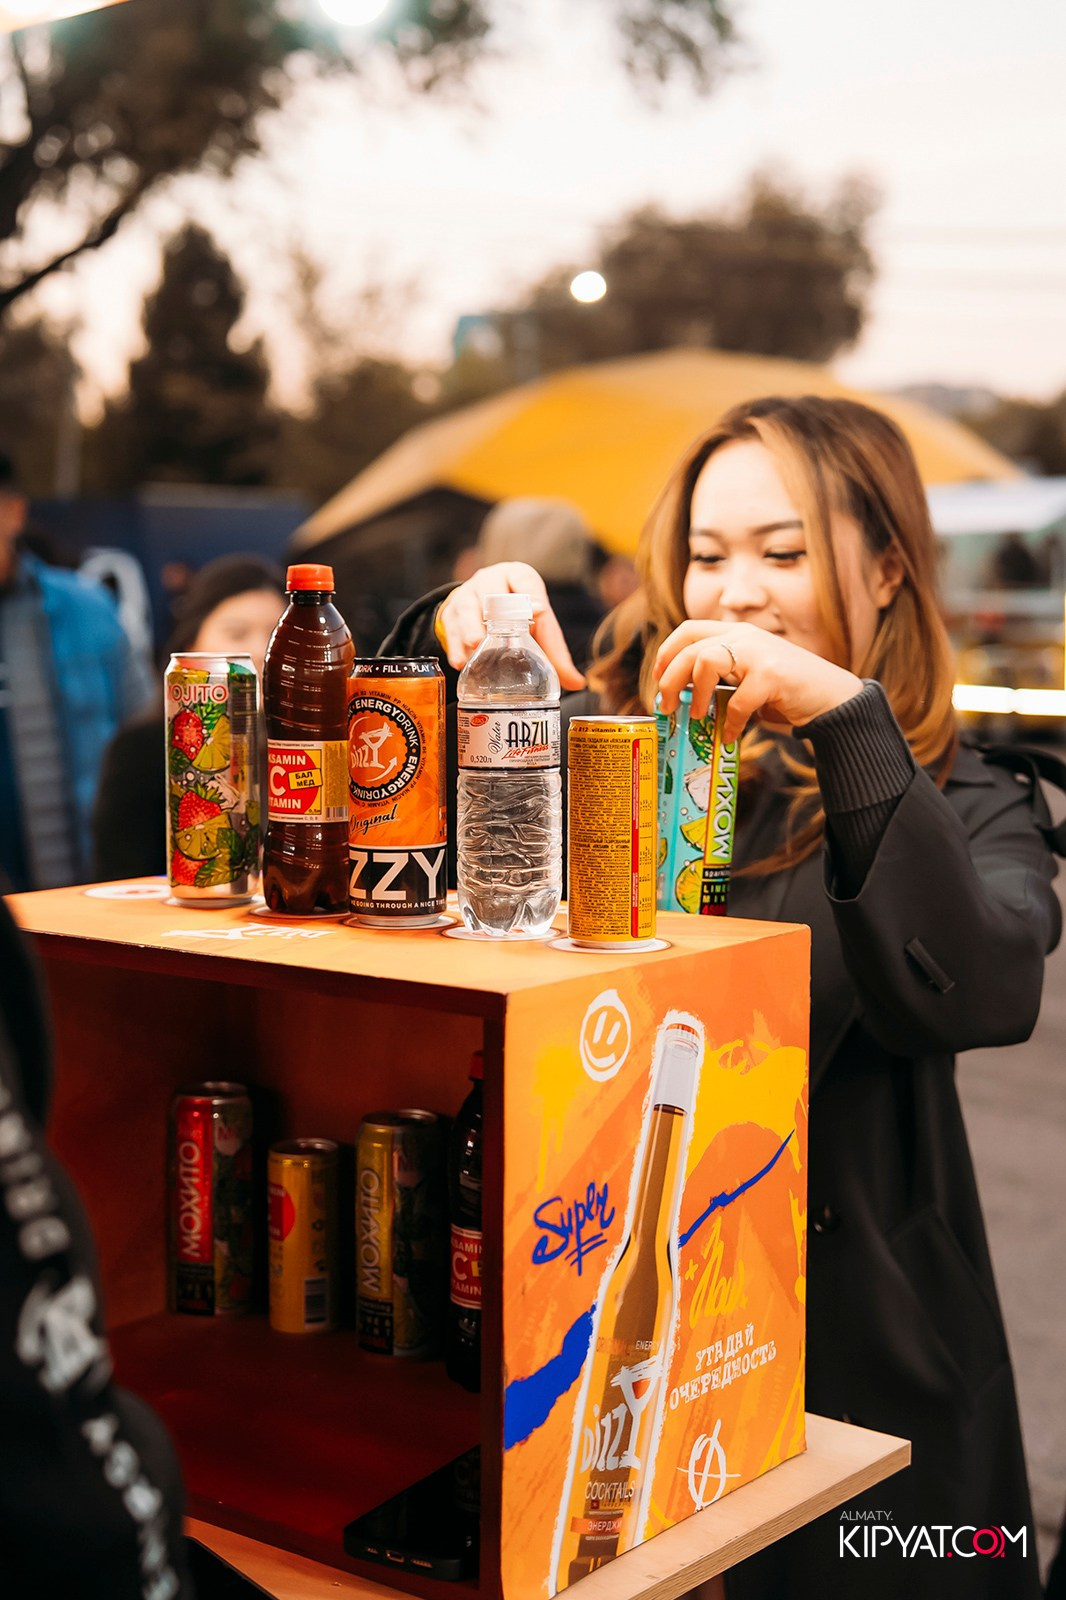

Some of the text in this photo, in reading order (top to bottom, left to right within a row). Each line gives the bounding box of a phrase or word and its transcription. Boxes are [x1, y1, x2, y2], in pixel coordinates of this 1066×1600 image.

[382, 664, 402, 673] FILL
[411, 664, 430, 673] PLAY
[168, 683, 229, 704] OJITO
[295, 771, 313, 780] БАЛ
[350, 803, 398, 836] Original
[420, 900, 435, 908] NICE
[179, 1141, 202, 1258] МОХИТО
[361, 1167, 382, 1292] МОХИТО
[532, 1181, 616, 1277] Super
[669, 1340, 777, 1411] ОЧЕРЕДНОСТЬ
[585, 1480, 636, 1500] COCKTAILS
[587, 1519, 623, 1532] ЭНЕРДЖИ
